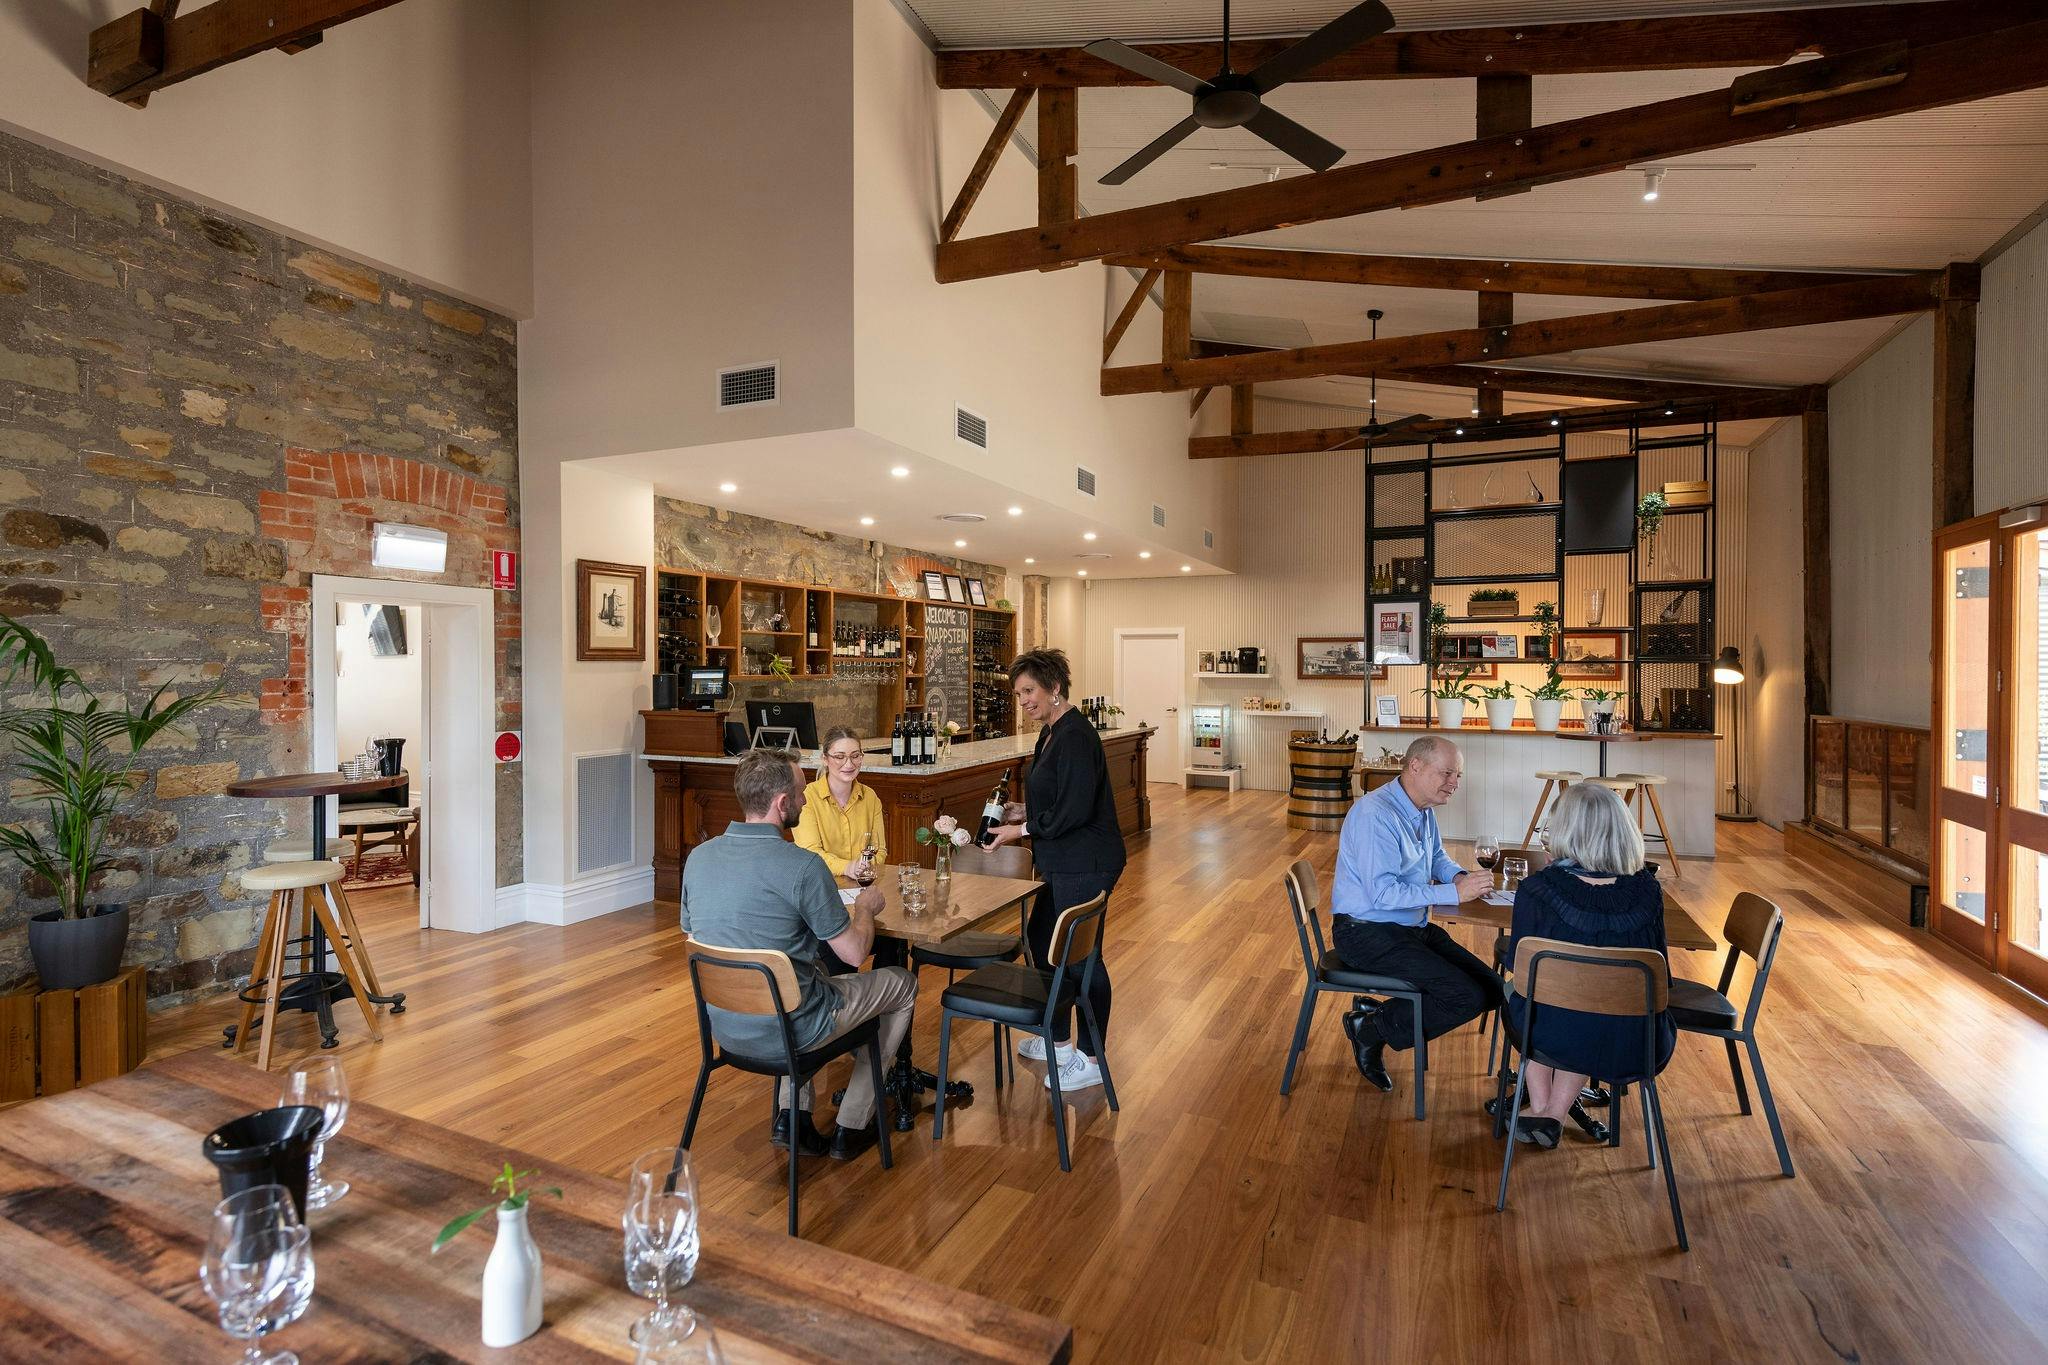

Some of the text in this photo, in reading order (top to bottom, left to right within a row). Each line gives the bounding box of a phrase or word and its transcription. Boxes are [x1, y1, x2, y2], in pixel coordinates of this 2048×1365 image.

[925, 606, 968, 626] WELCOME TO
[924, 625, 969, 644] KNAPPSTEIN
